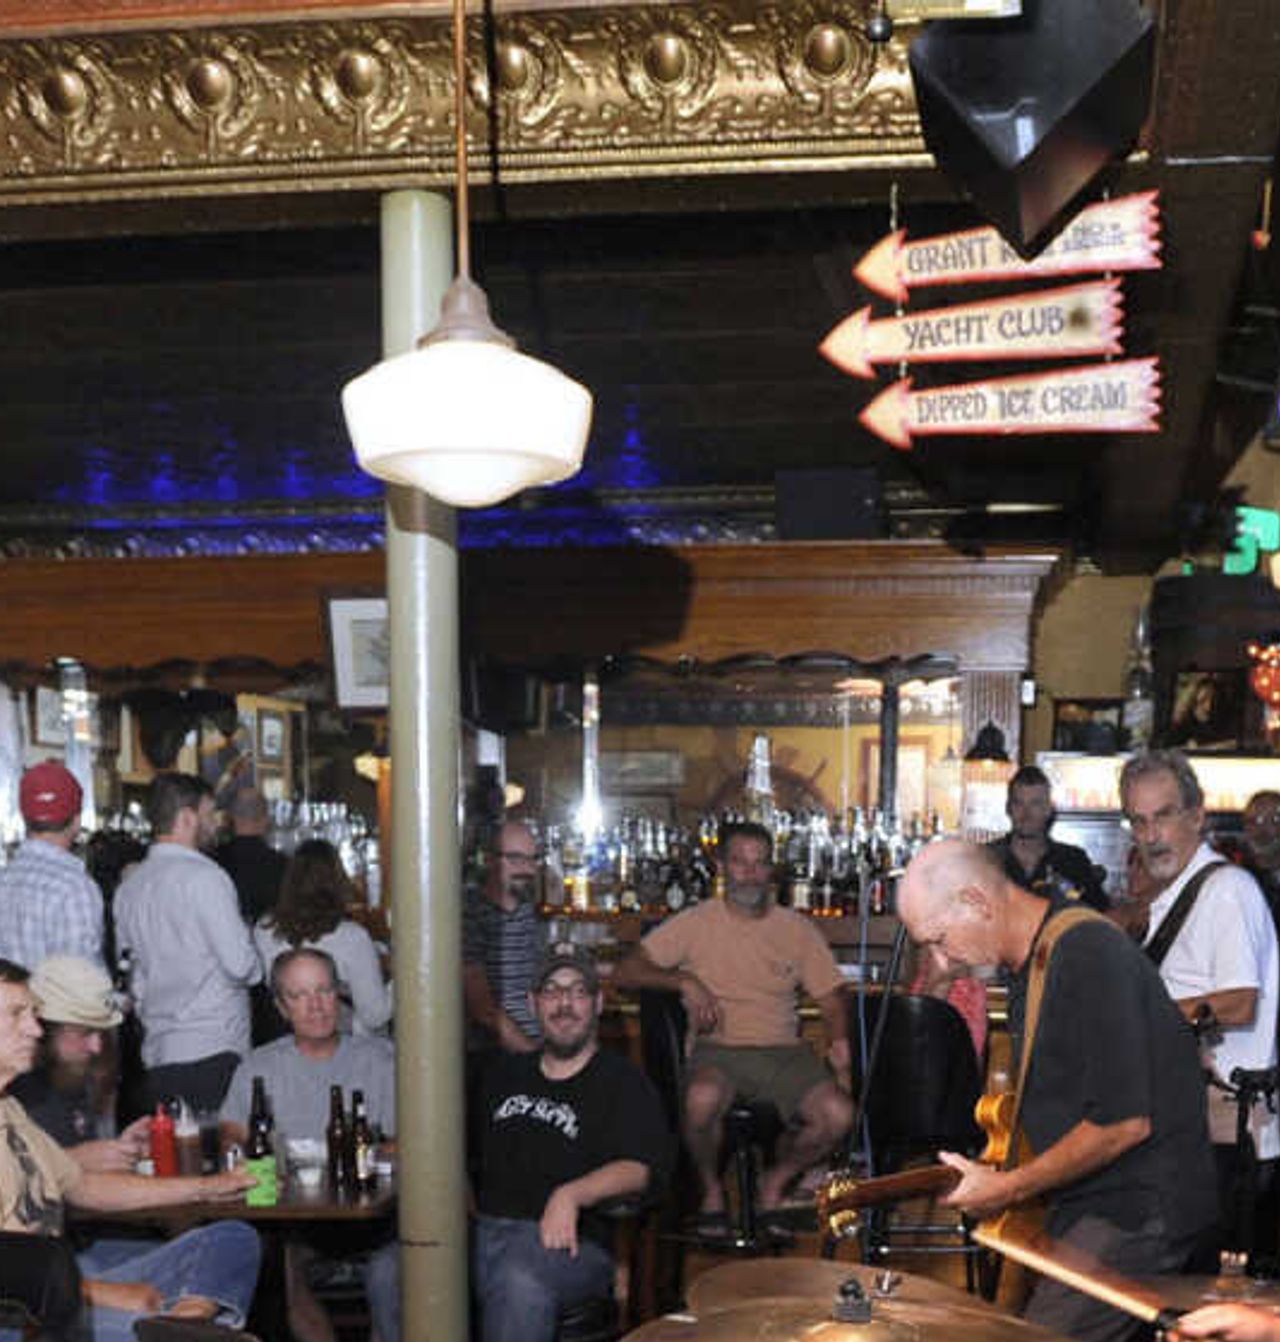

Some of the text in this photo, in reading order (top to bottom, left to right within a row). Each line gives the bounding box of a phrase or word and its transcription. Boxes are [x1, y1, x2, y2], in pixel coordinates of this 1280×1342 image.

[907, 236, 990, 274] GRANT
[904, 305, 1065, 350] YACHT CLUB
[915, 381, 1127, 424] DIPPED ICE CREAM
